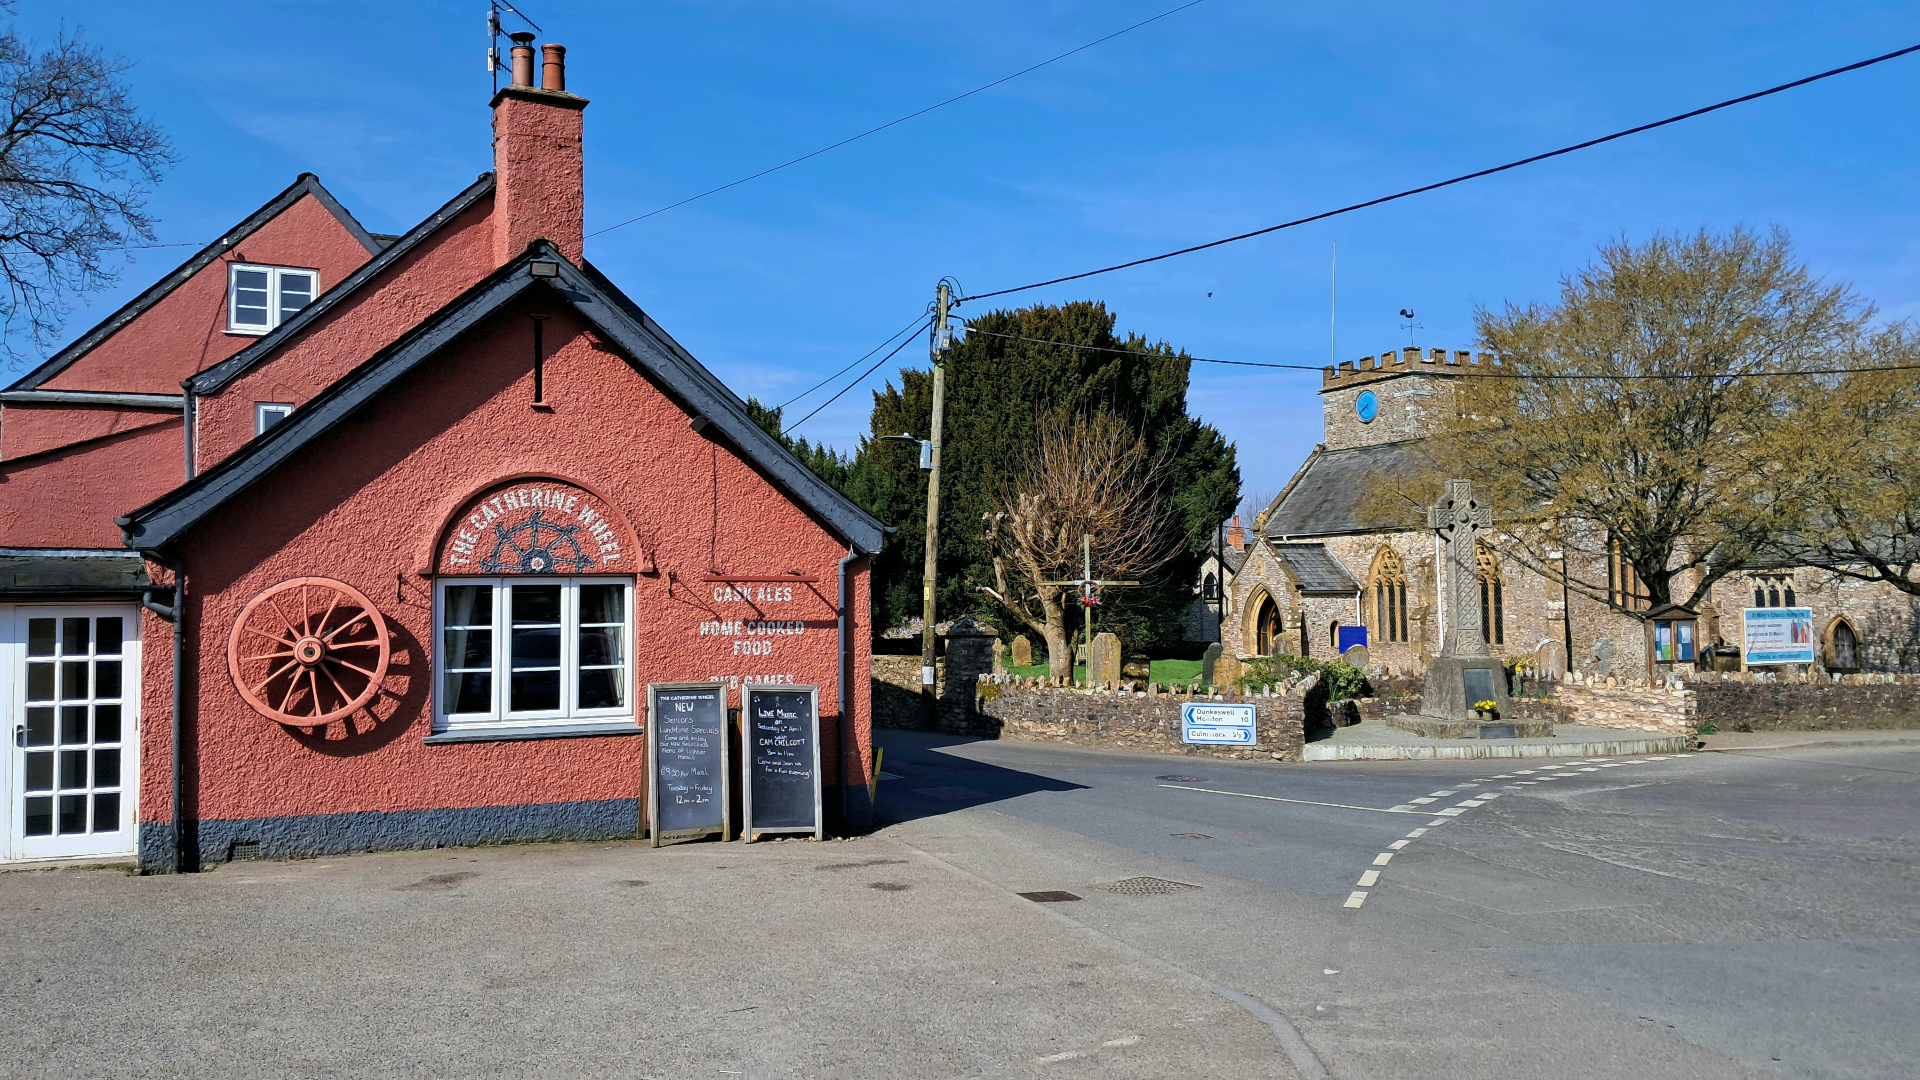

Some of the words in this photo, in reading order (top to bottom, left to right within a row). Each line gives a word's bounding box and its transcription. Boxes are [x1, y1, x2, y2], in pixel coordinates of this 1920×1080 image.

[450, 528, 479, 565] THE
[470, 487, 579, 530] CATHERINE
[577, 504, 621, 565] WHEEL
[713, 586, 752, 602] CASK
[757, 586, 793, 602] ALES
[700, 620, 742, 636] HOME
[747, 620, 805, 636] COOKED
[733, 640, 772, 656] FOOD
[675, 702, 694, 712] NEW
[664, 714, 694, 724] Seniors
[691, 724, 719, 734] Specials
[774, 738, 806, 746] CHILCOTT
[690, 766, 710, 776] Meal
[694, 784, 712, 794] Friday
